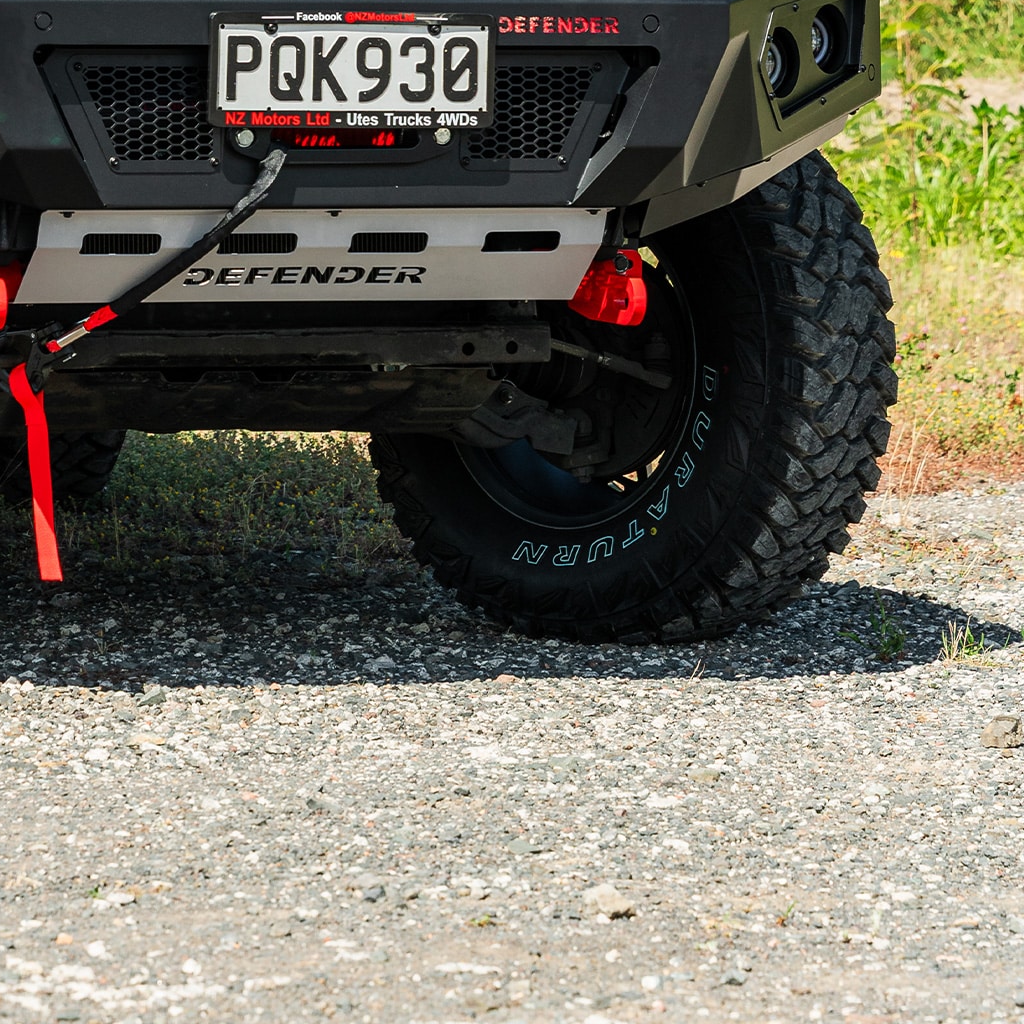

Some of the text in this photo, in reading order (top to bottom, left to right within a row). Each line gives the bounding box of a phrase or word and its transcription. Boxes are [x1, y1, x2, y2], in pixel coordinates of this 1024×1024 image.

[296, 11, 342, 22] Facebook
[498, 15, 620, 34] DEFENDER
[225, 35, 479, 103] PQK930
[225, 112, 246, 126] NZ
[251, 111, 301, 126] Motors
[306, 112, 331, 126] Ltd
[346, 113, 379, 126] Utes
[384, 112, 432, 127] Trucks
[436, 113, 479, 127] 4WDs
[182, 266, 428, 287] DEFENDER
[512, 364, 719, 567] DURATURN
